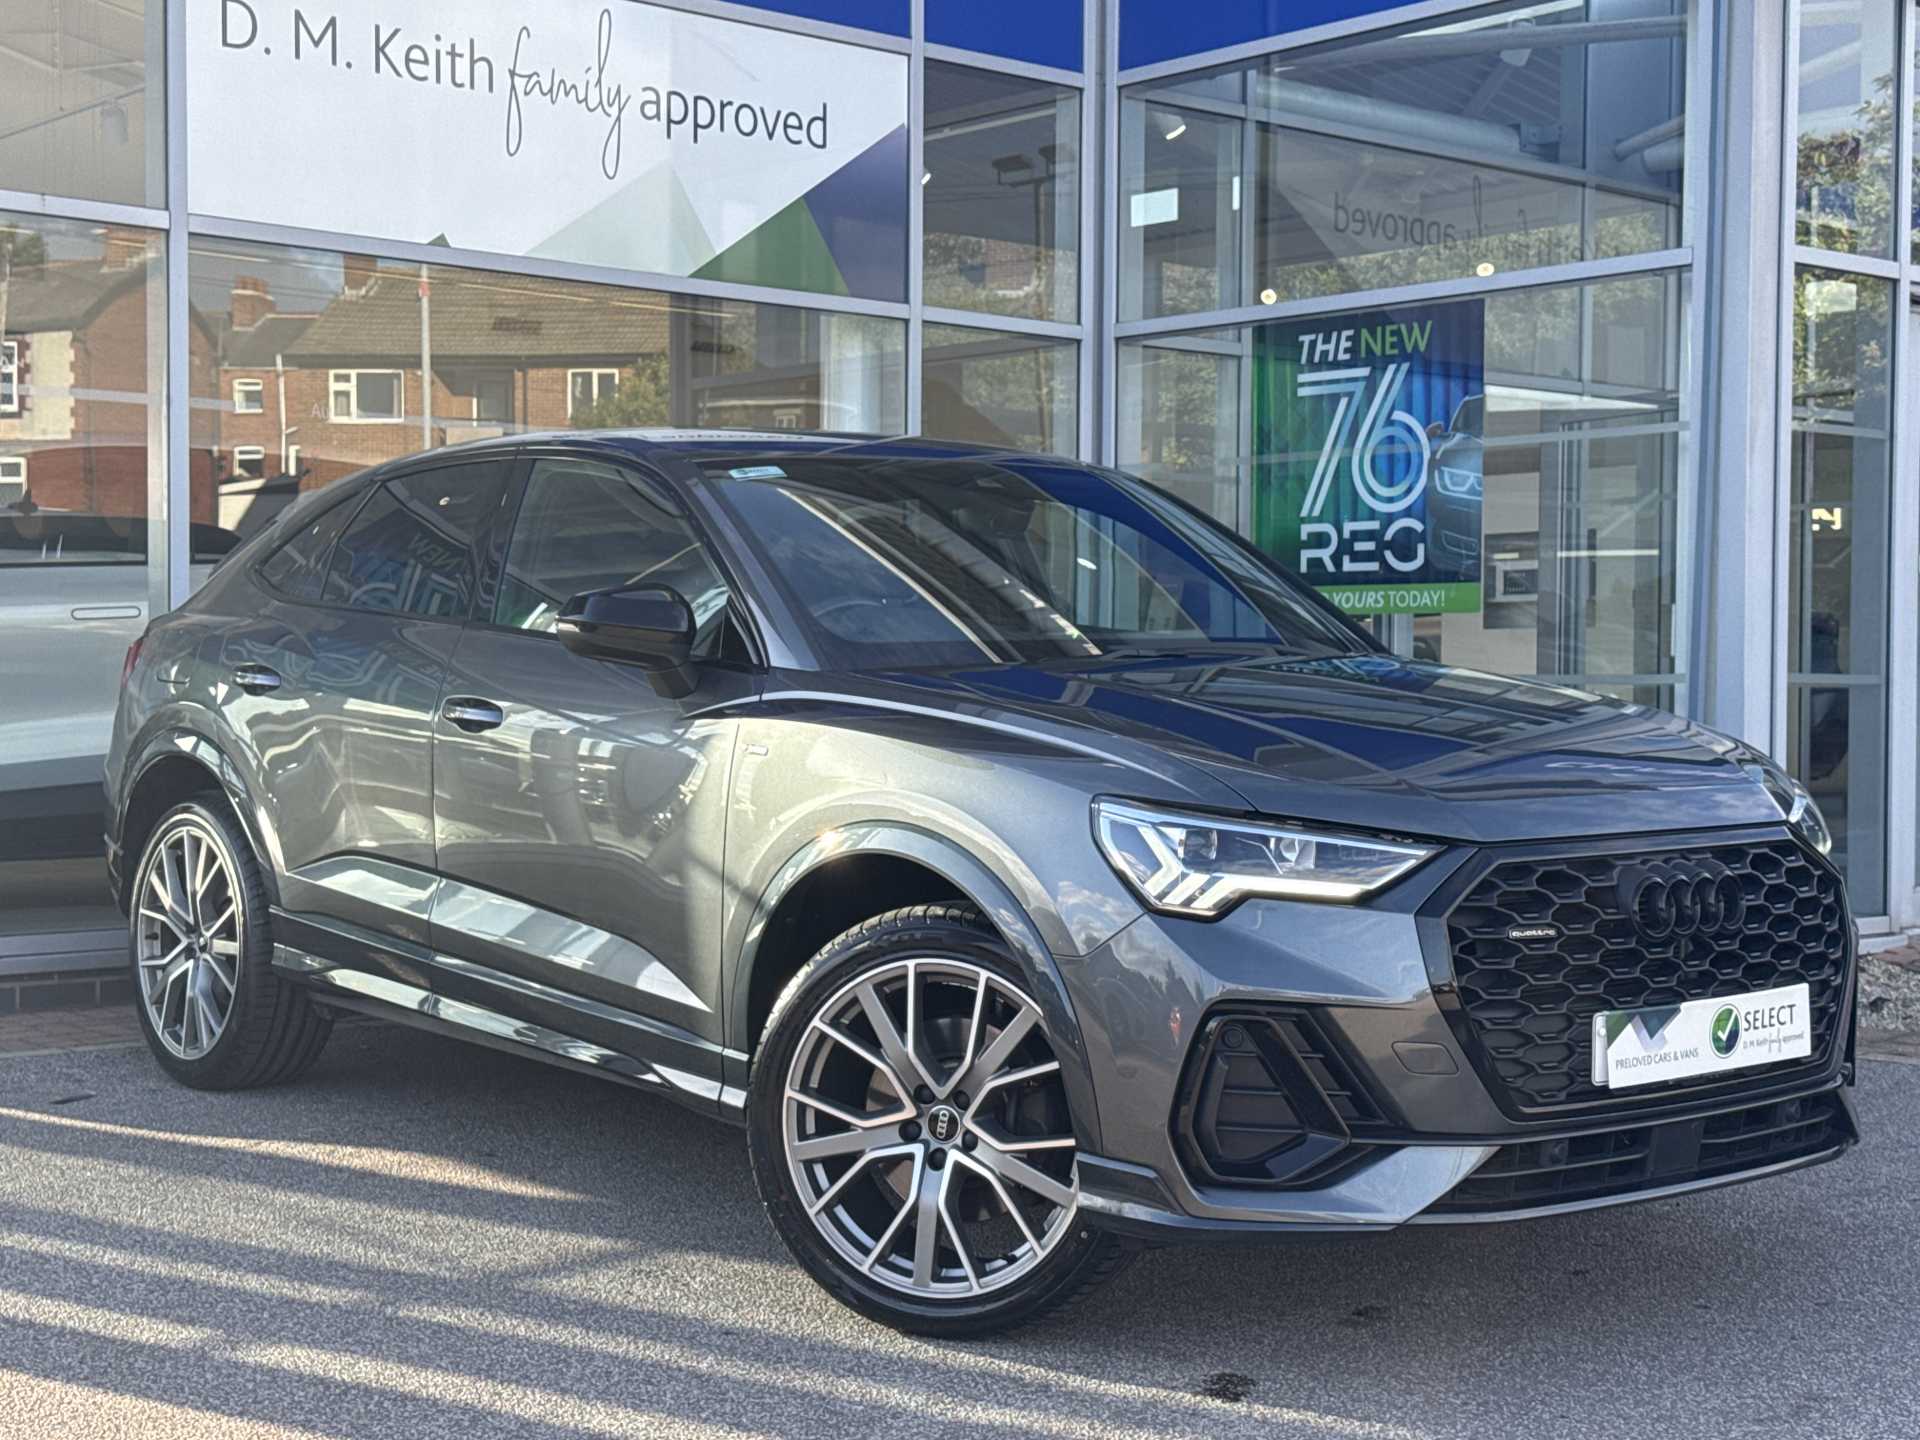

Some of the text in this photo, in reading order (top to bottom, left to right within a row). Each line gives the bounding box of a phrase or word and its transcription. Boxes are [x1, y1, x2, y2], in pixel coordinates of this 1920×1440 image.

[221, 0, 828, 181] D. M. Keith family approved
[1298, 320, 1433, 365] THE NEW
[1296, 361, 1431, 517] 76
[1299, 517, 1425, 574] REG
[1332, 591, 1385, 608] YOURS
[1387, 589, 1445, 608] TODAY!
[1743, 1004, 1797, 1032] SELECT
[1615, 1046, 1699, 1070] PRELOVED CARS & VANS
